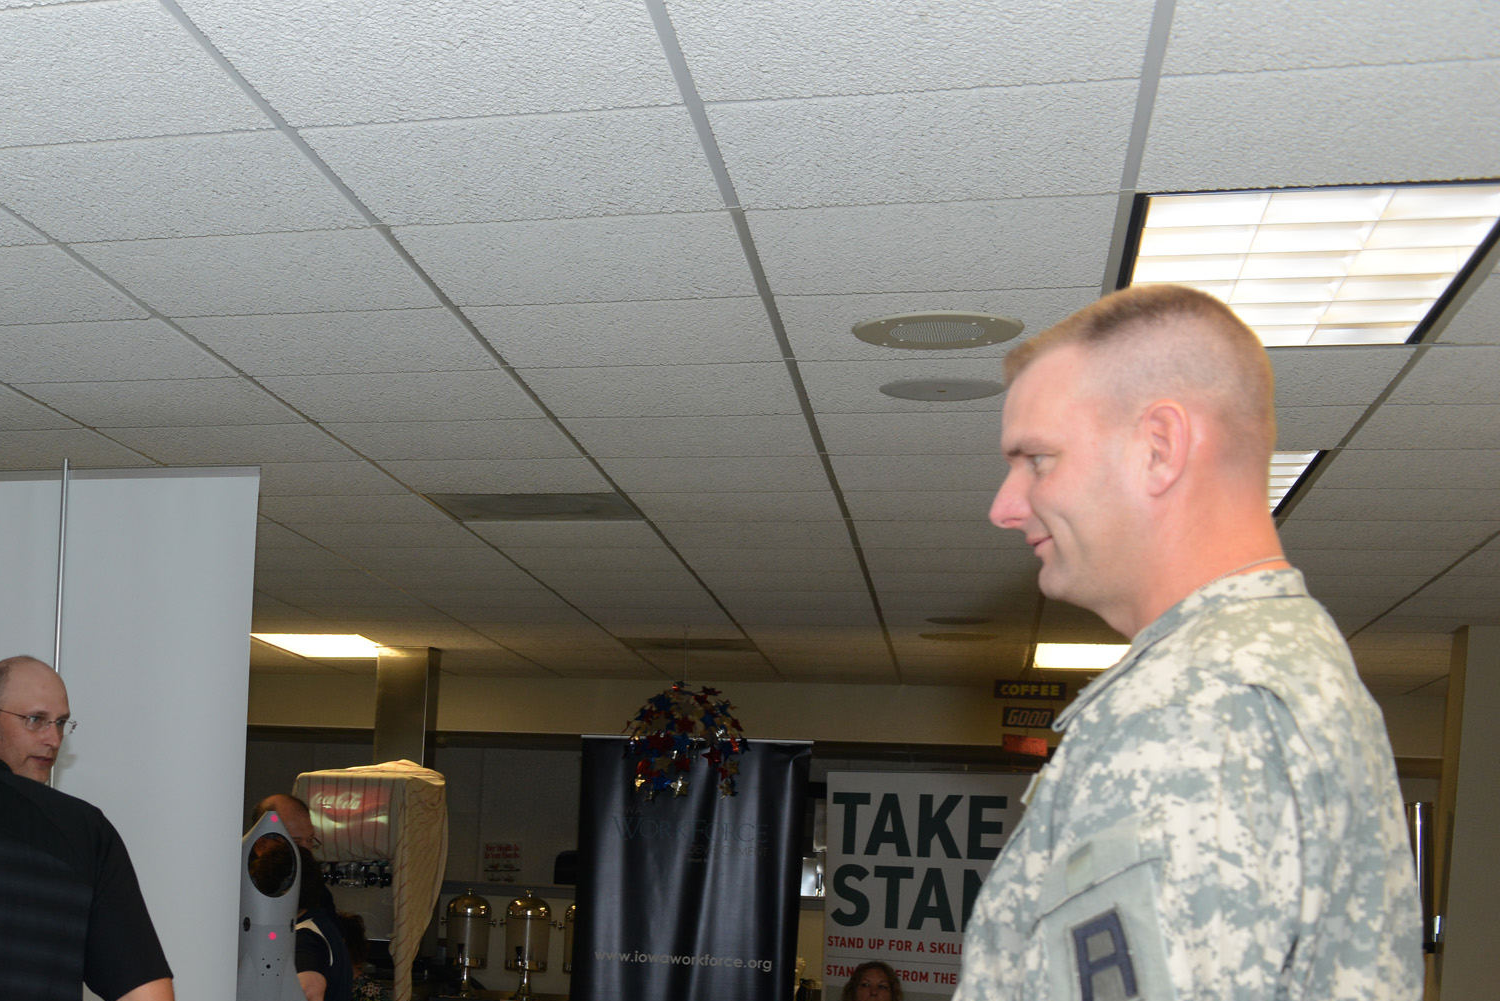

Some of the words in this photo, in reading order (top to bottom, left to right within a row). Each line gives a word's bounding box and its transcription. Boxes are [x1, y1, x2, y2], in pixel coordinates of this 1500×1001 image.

[1001, 684, 1060, 696] COFFEE
[833, 792, 1008, 860] TAKE
[828, 936, 864, 949] STAND
[869, 938, 884, 950] UP
[889, 939, 912, 952] FOR
[916, 941, 925, 953] A
[594, 951, 772, 973] www.iowaworkforce.org
[896, 969, 929, 982] FROM
[934, 972, 956, 985] THE
